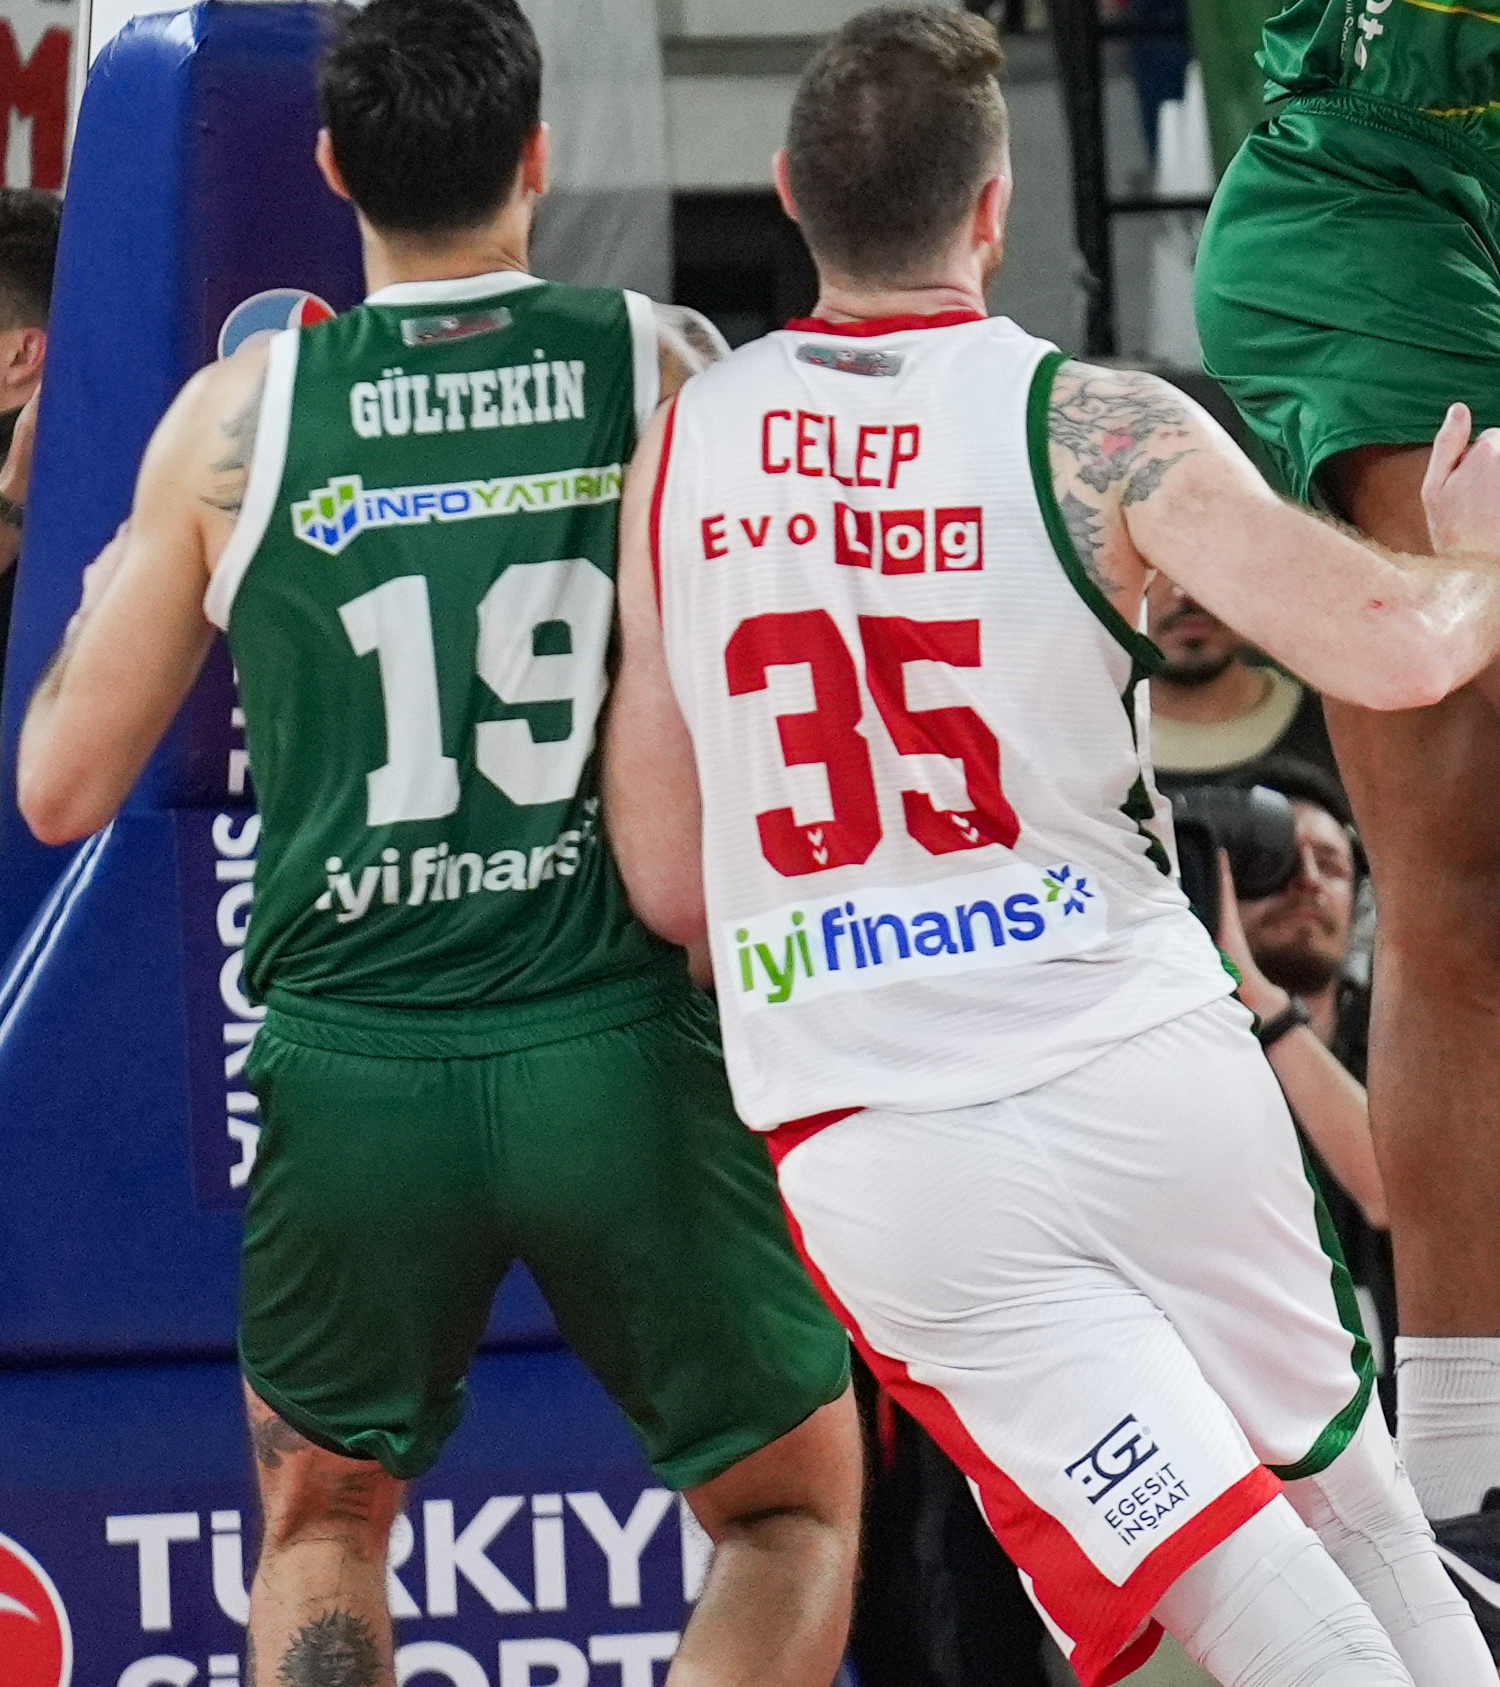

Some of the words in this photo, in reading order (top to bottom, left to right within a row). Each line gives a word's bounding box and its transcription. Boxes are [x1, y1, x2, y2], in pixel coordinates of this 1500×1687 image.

[349, 347, 586, 438] GÜLTEKİN
[760, 408, 921, 489] CELEP
[337, 557, 613, 827] 19
[724, 608, 1021, 878] 35
[315, 830, 582, 924] iyifinans
[735, 887, 1046, 1005] iyifinans
[1118, 1483, 1192, 1546] İNŞAAT
